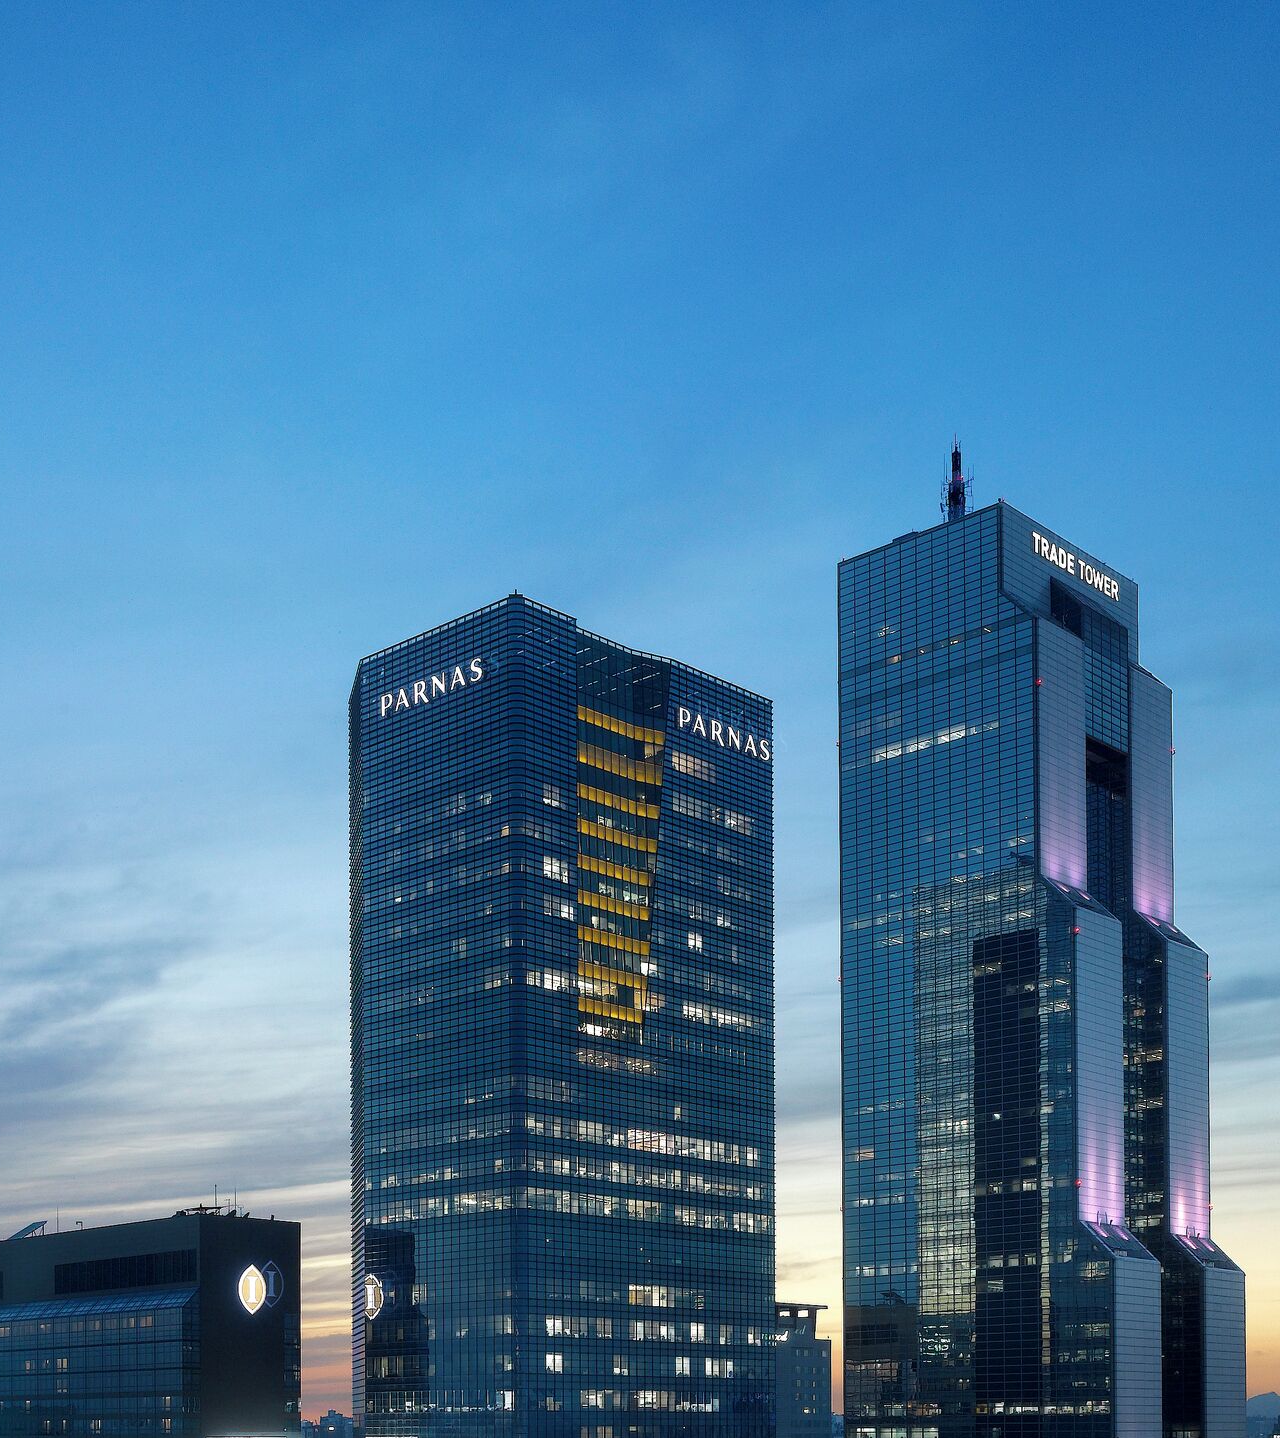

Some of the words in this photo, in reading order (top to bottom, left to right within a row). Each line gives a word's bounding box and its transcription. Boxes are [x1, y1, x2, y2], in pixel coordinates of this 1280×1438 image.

[1032, 530, 1075, 575] TRADE
[1077, 558, 1120, 602] TOWER
[380, 657, 484, 717] PARNAS
[677, 706, 771, 762] PARNAS
